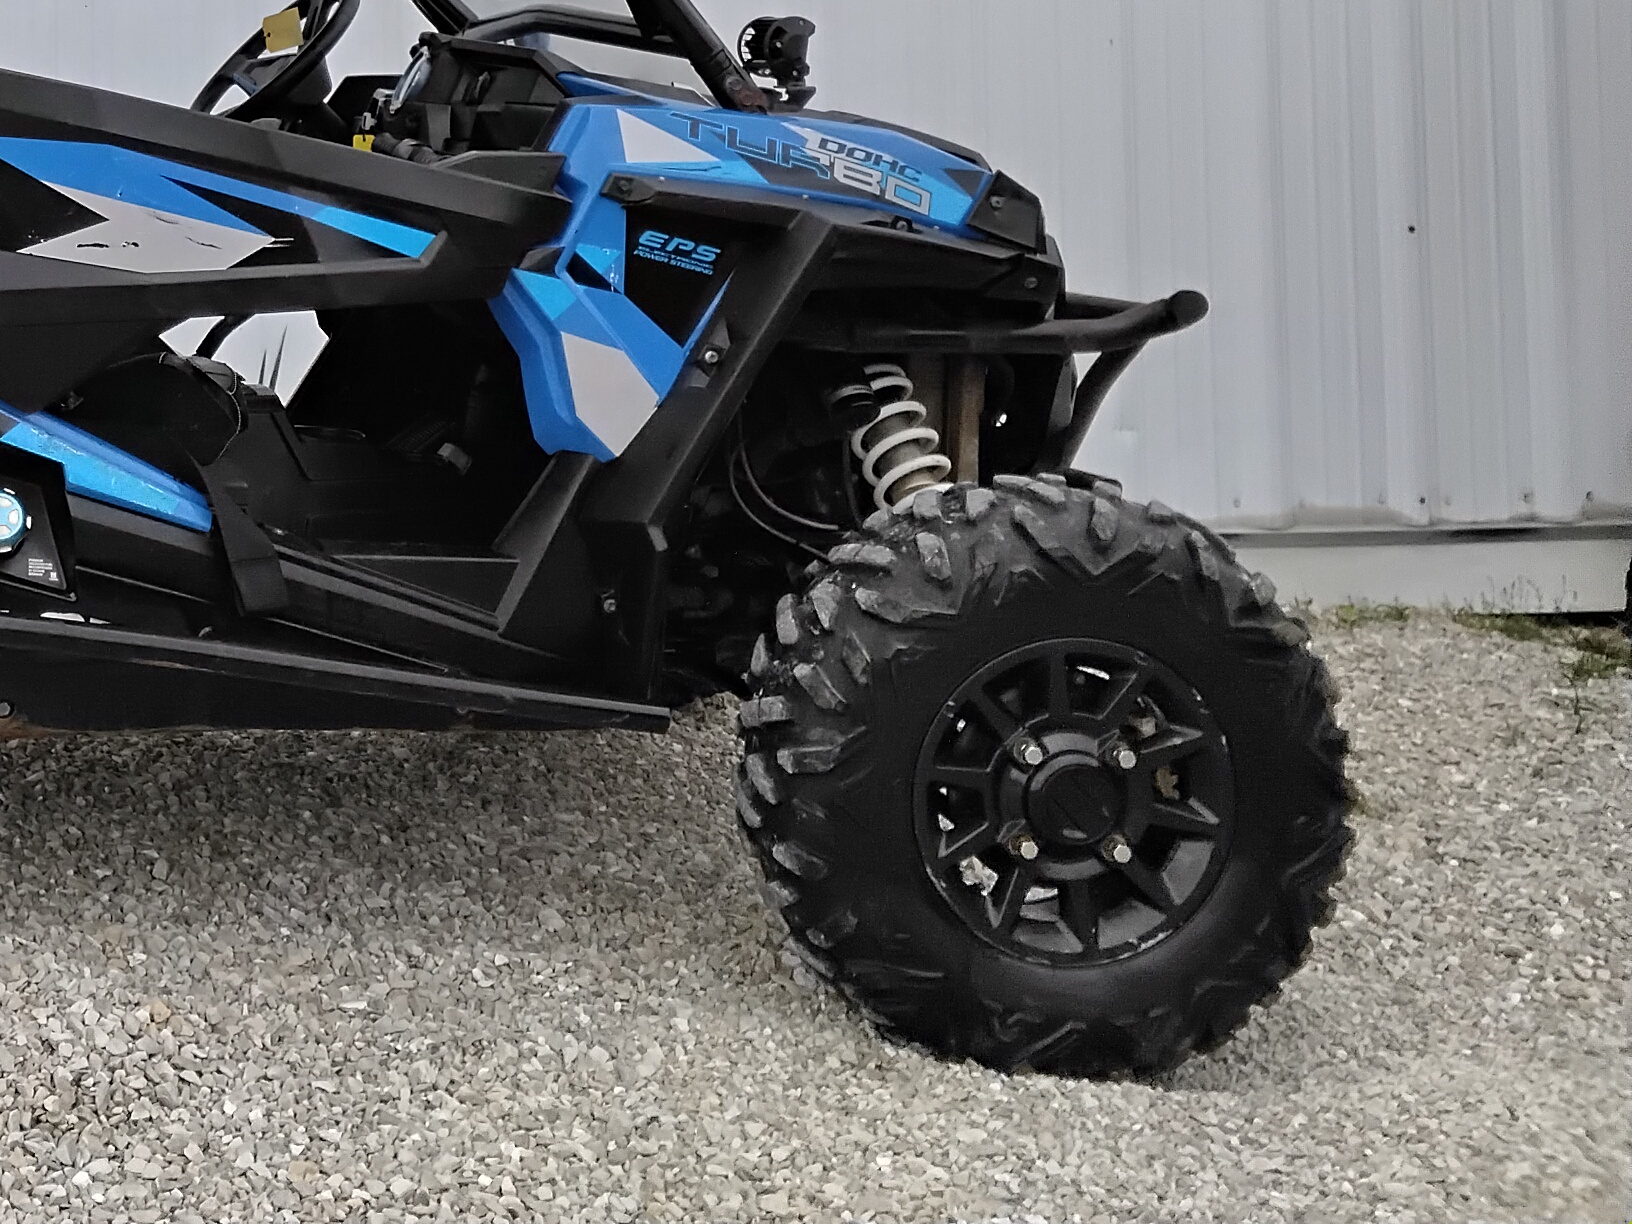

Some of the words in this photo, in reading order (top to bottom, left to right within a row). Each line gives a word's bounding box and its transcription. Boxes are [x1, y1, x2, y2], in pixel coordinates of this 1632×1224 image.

[669, 111, 932, 216] TURBO
[818, 137, 922, 183] DOHC
[633, 250, 669, 263] POWER
[638, 230, 722, 262] EPS
